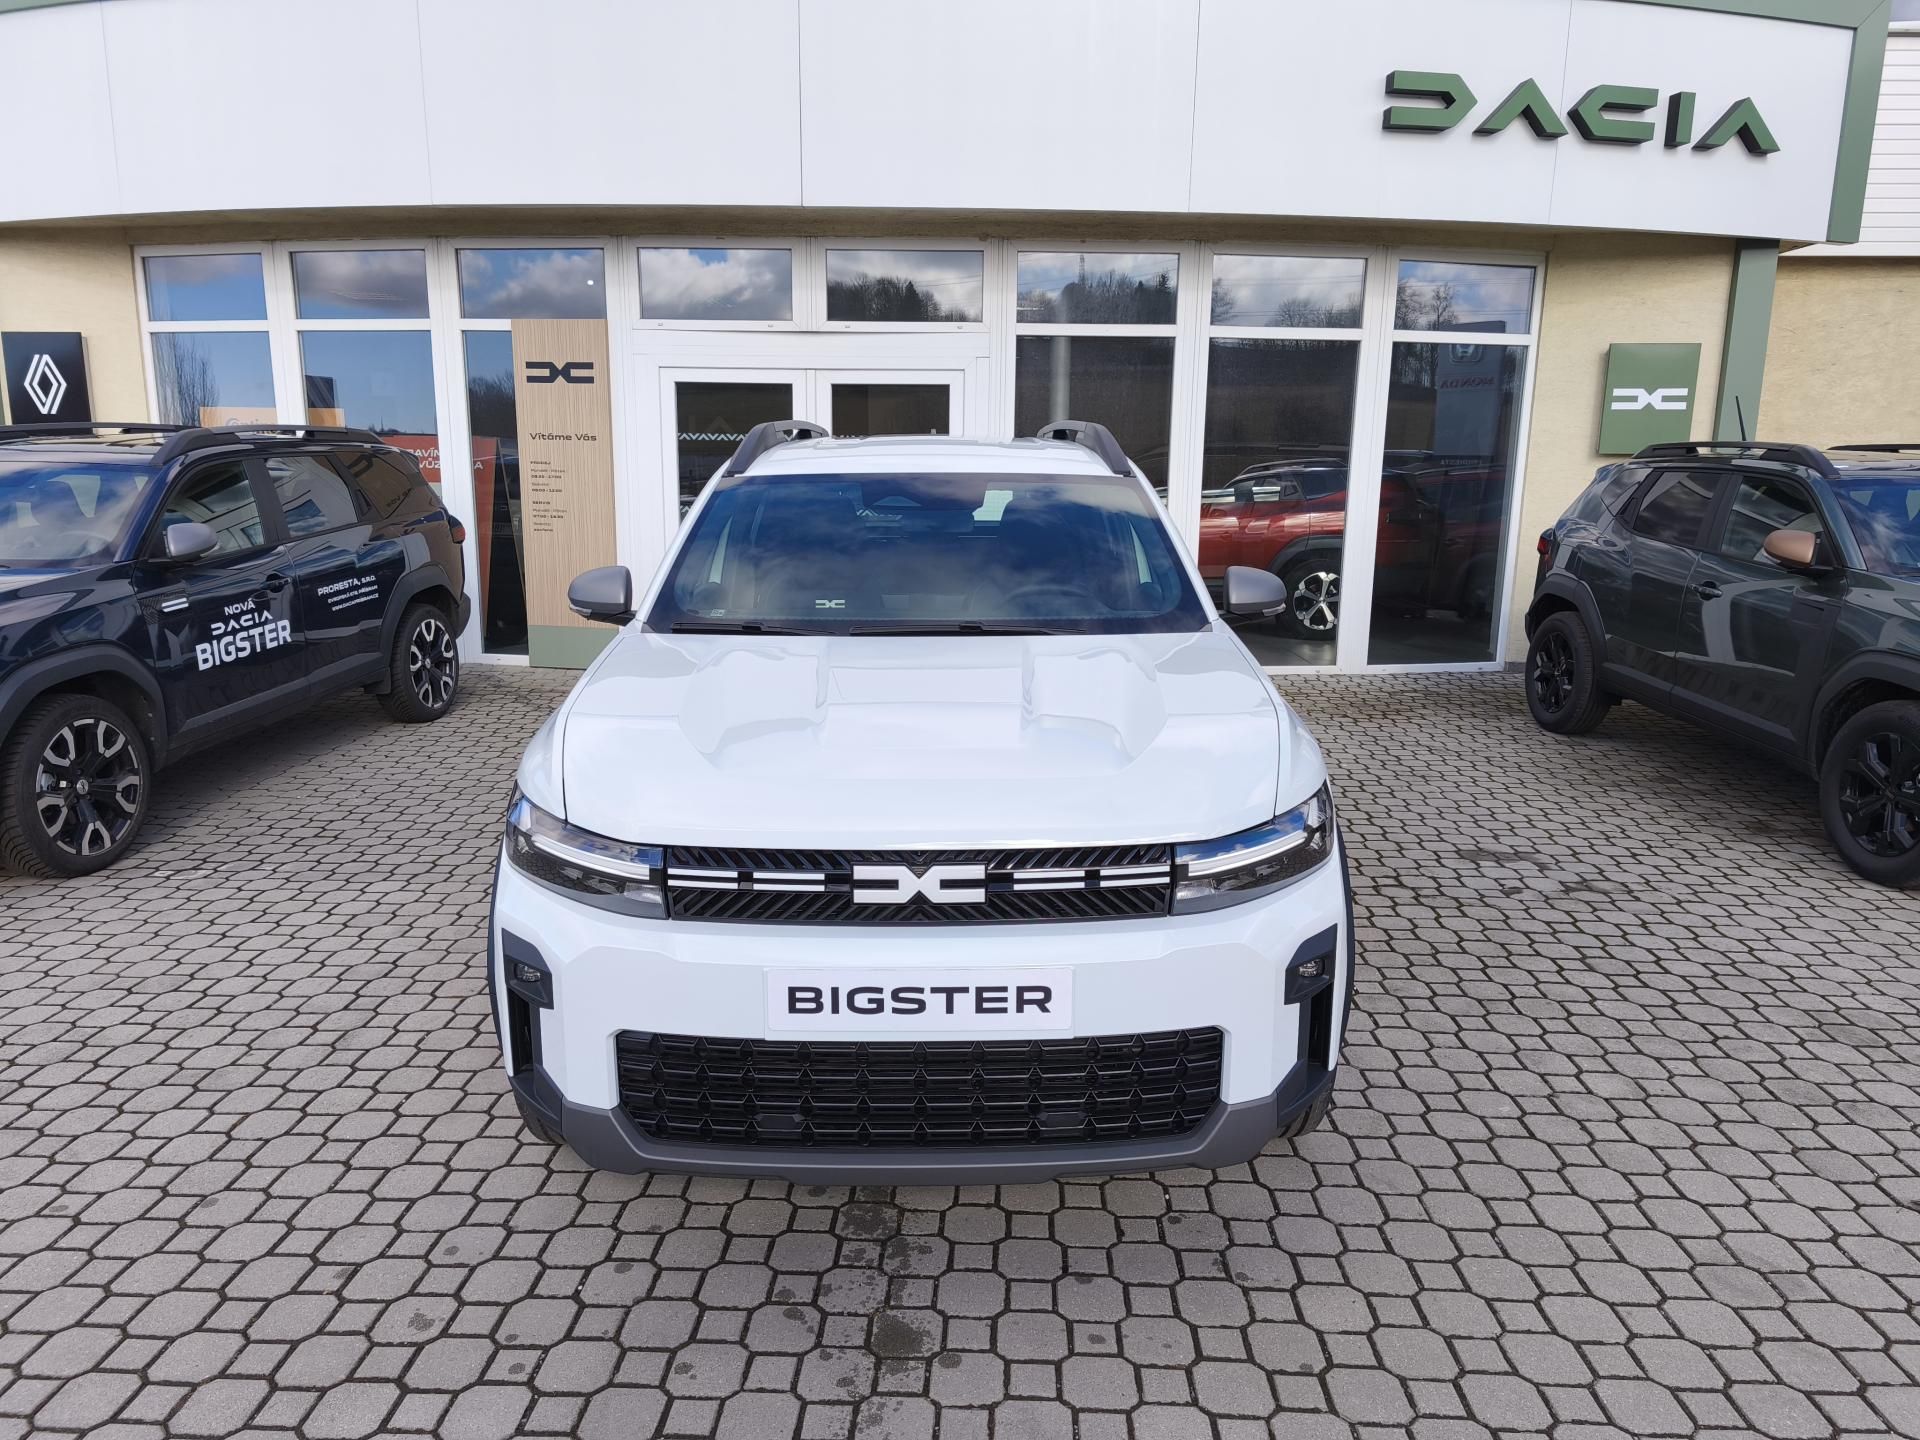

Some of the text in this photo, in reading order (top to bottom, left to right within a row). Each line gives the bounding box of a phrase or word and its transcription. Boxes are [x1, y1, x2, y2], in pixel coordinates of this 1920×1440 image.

[1382, 69, 1781, 156] DACIA
[529, 432, 597, 441] Vítáme Vás
[317, 578, 361, 597] PRORESTA,
[224, 598, 256, 616] NOVÁ
[210, 609, 273, 636] DACIA
[195, 619, 292, 671] BIGSTER
[787, 985, 1053, 1015] BIGSTER
